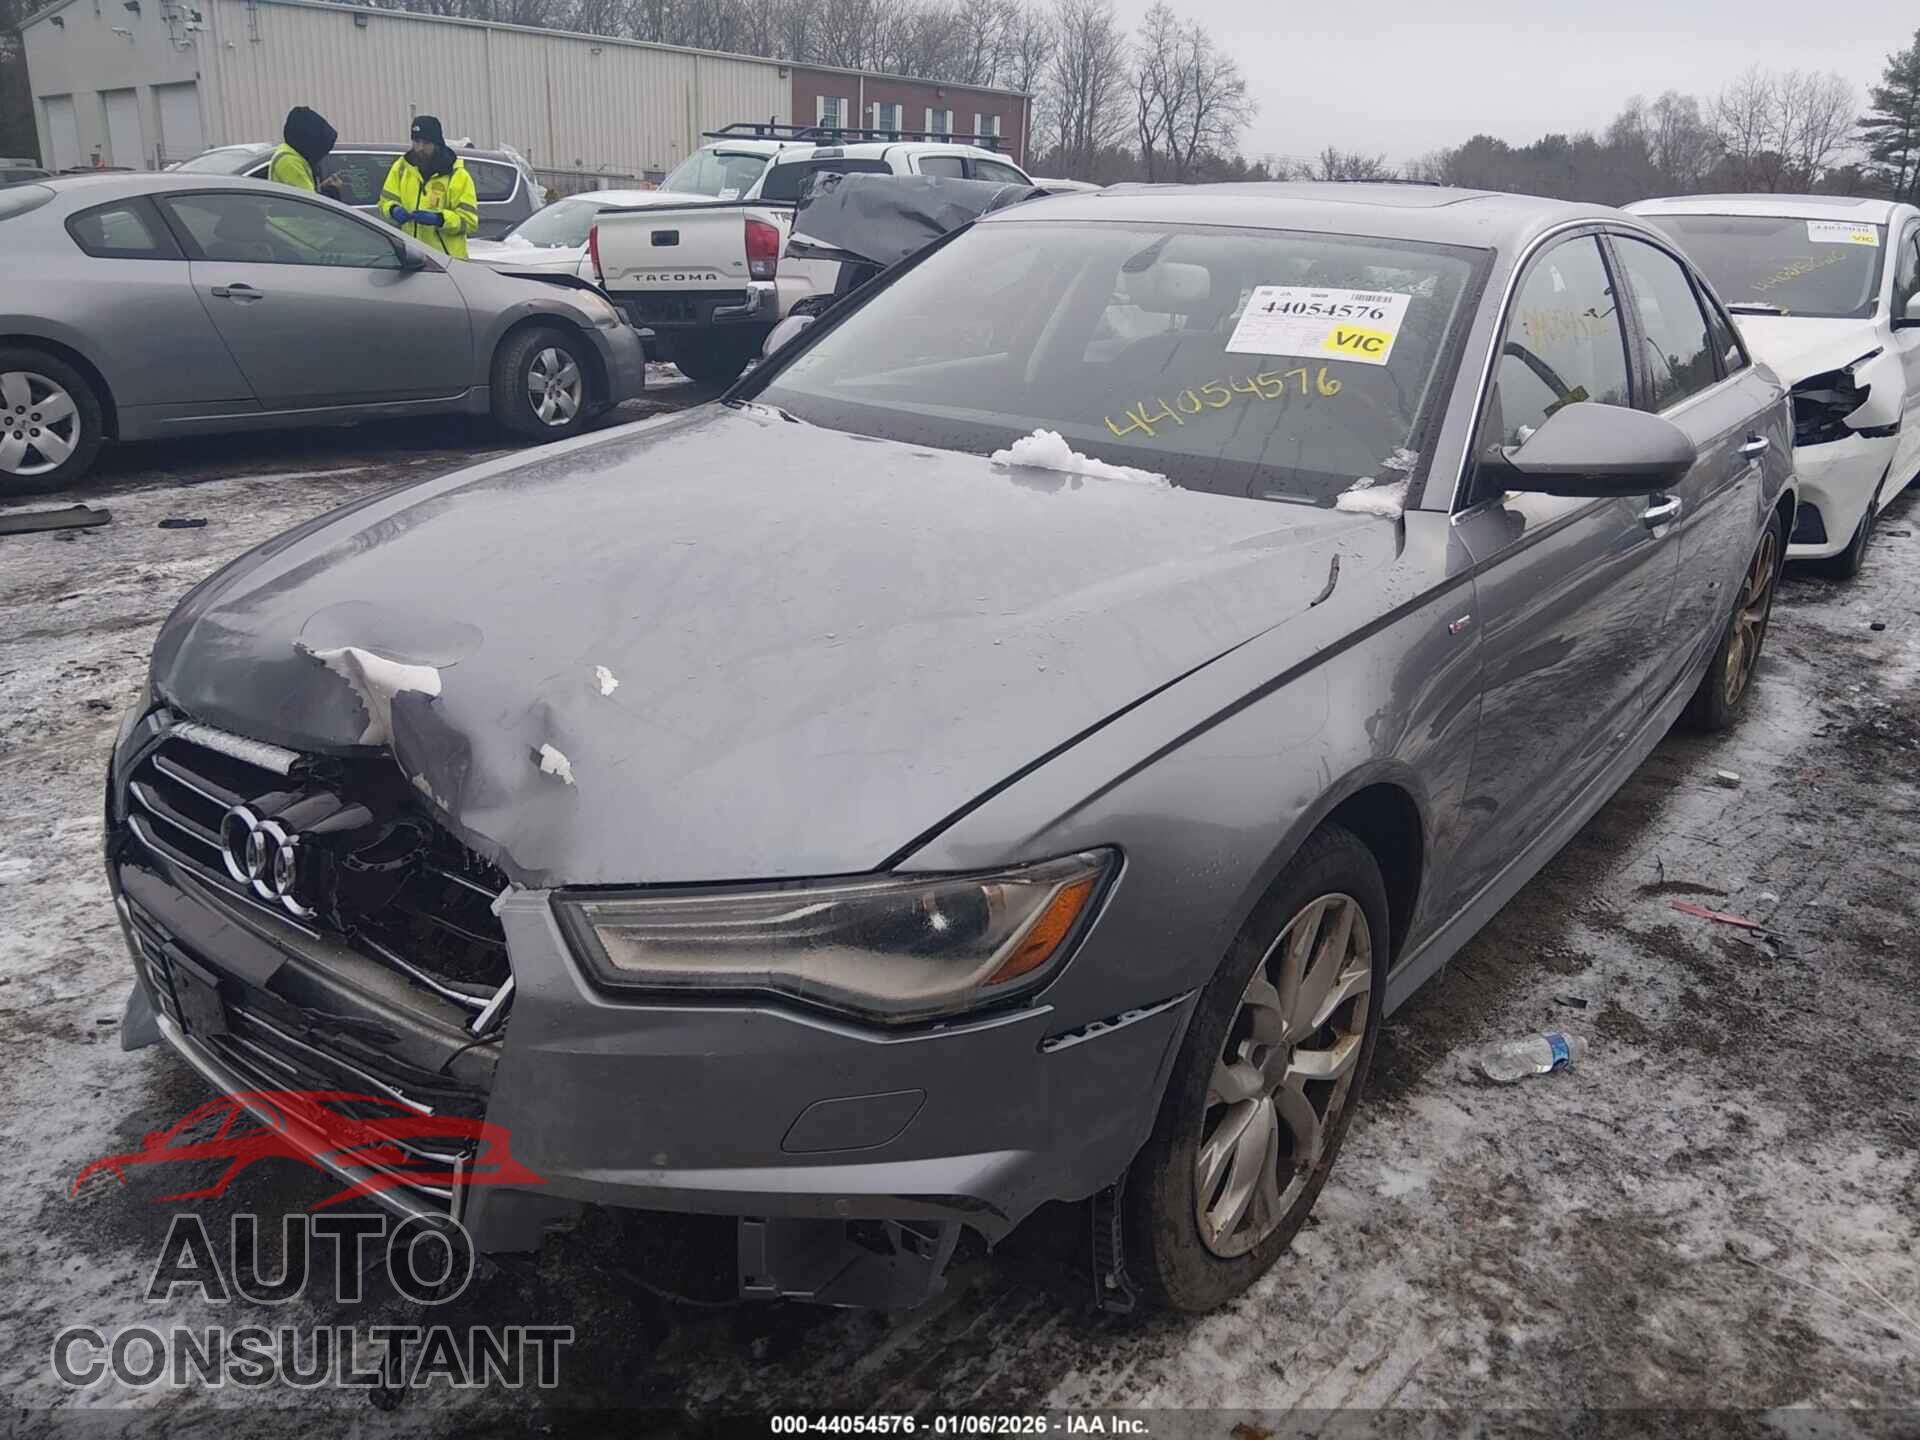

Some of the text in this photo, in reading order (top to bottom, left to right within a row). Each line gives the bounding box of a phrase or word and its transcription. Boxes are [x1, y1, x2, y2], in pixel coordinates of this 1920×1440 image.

[1262, 301, 1384, 320] 44054576
[1336, 331, 1383, 353] VIC
[1104, 367, 1342, 437] 44054576
